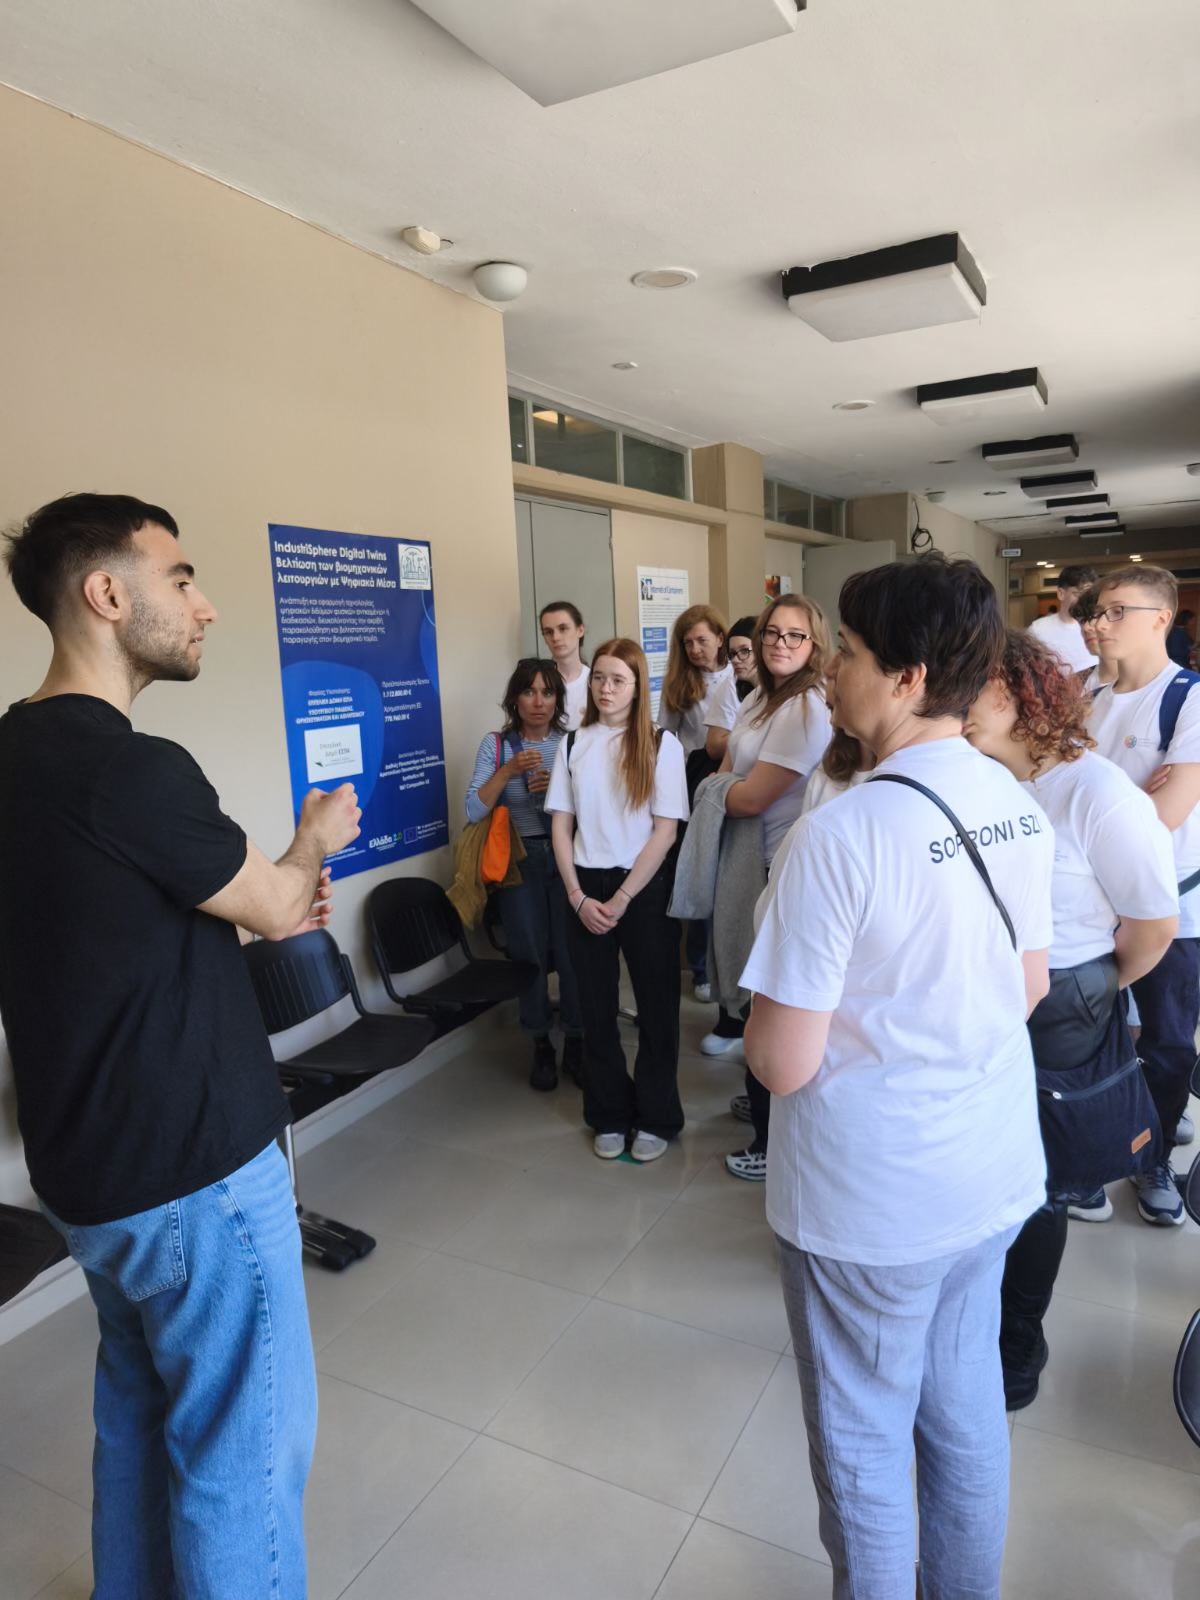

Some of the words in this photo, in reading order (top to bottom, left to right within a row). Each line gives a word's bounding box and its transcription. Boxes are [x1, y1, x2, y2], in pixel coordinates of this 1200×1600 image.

[274, 541, 337, 557] IndustriSphere
[339, 547, 366, 561] Digital
[367, 549, 387, 561] Twins
[276, 557, 317, 572] Βελτίωση
[318, 562, 333, 571] των
[335, 561, 387, 575] βιομηχανικών
[277, 572, 328, 587] λειτουργιών
[330, 578, 340, 587] με
[341, 576, 375, 589] Ψηφιακά
[376, 578, 396, 588] Μέσα
[929, 819, 1015, 864] SOPRONI
